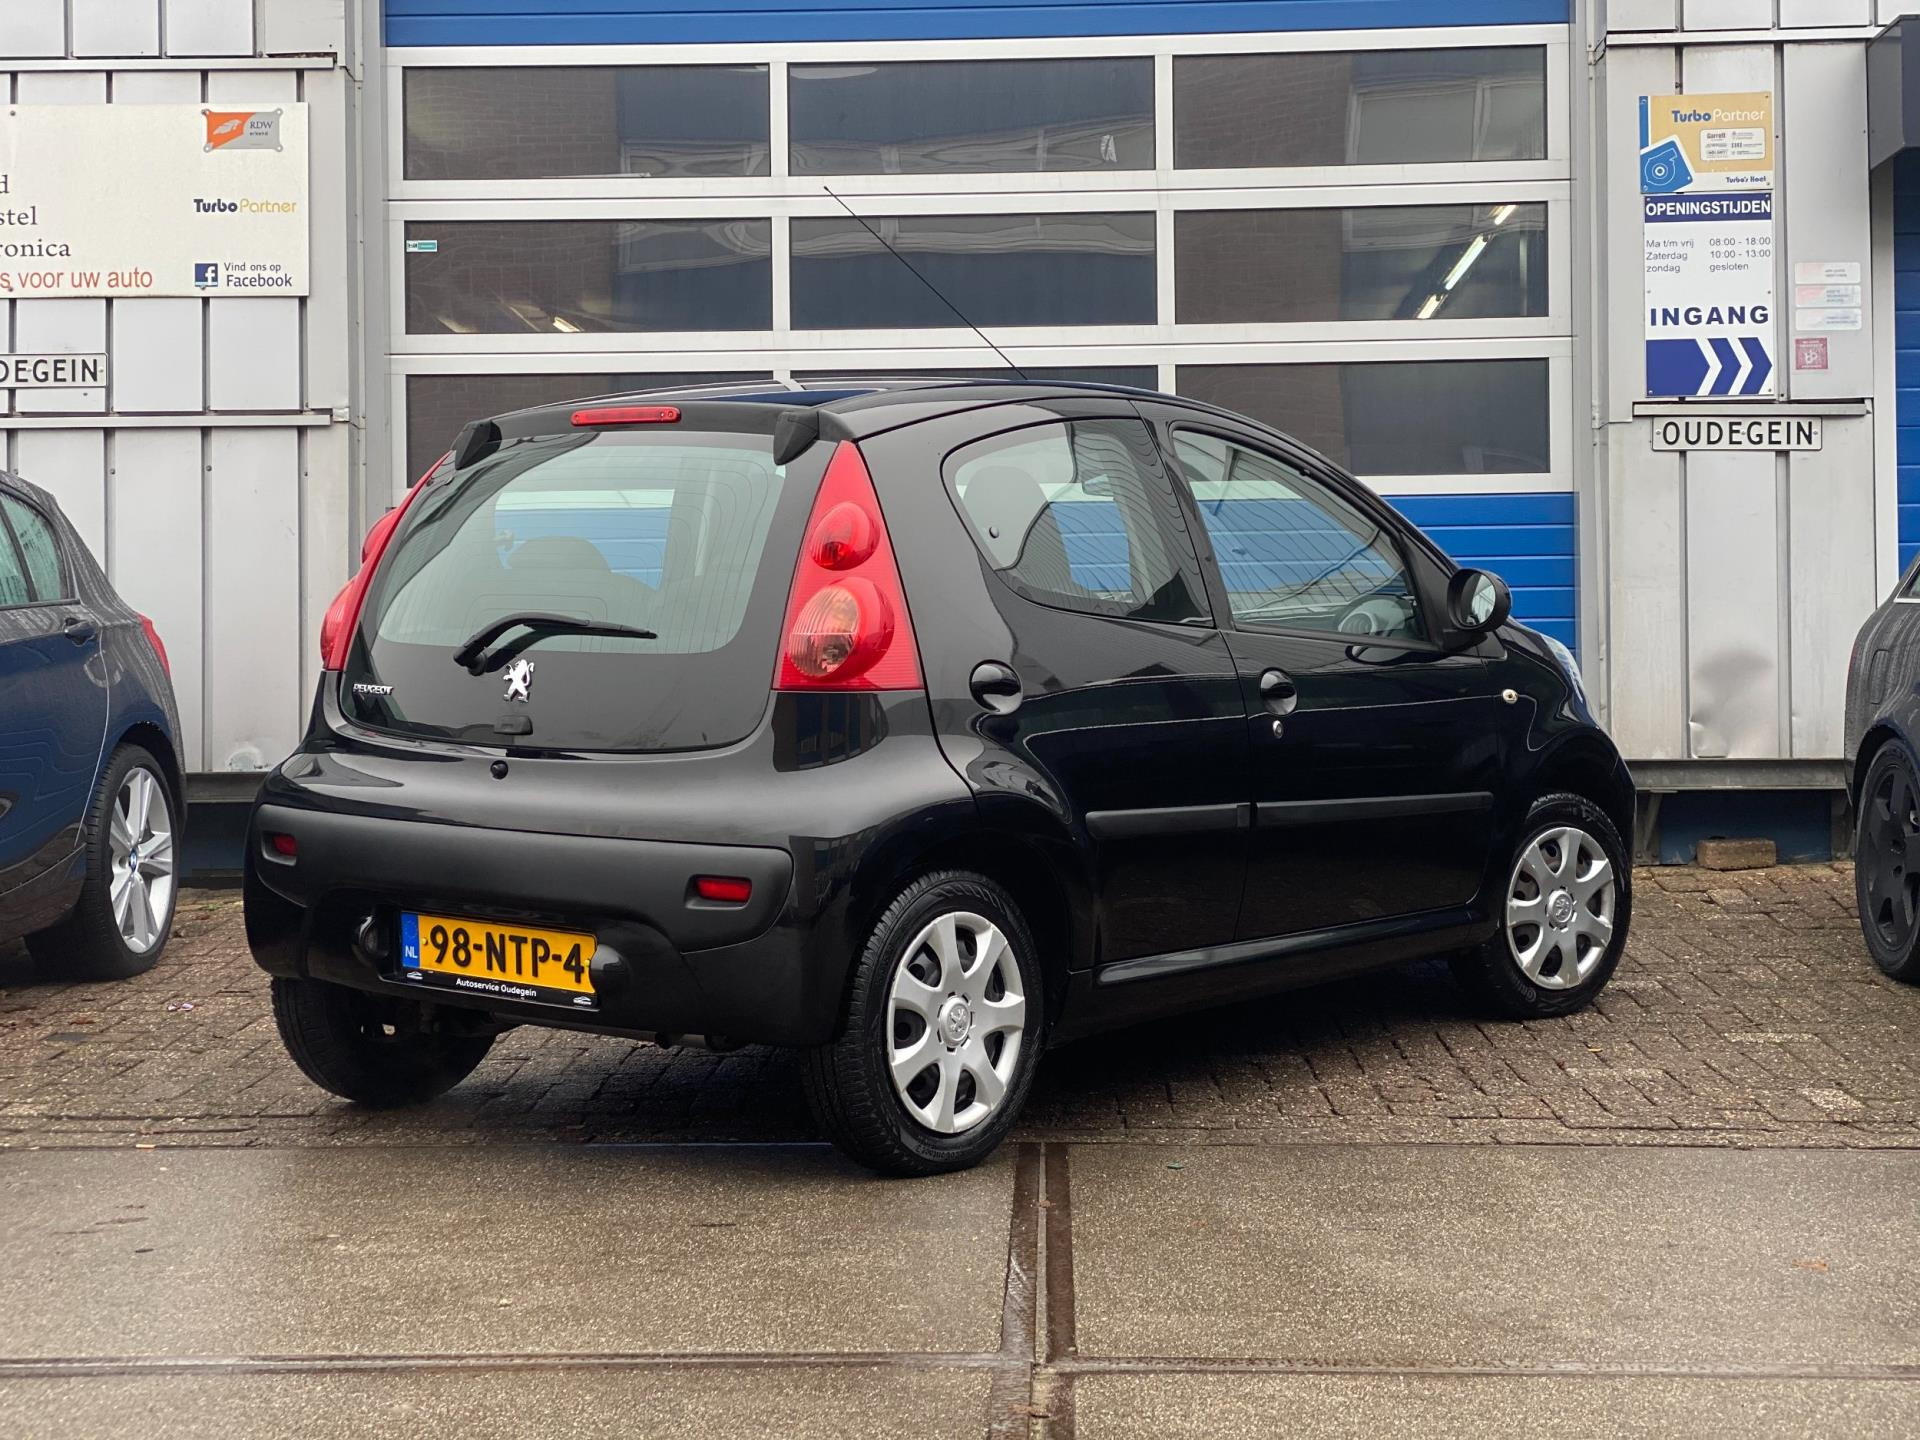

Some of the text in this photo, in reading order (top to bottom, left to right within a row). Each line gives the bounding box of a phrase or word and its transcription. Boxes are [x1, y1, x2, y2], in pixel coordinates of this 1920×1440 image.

[249, 120, 273, 129] RDW
[1645, 199, 1771, 216] OPENINGSTIJDEN
[1645, 239, 1661, 248] Ma
[1663, 239, 1678, 248] t/m
[1681, 239, 1694, 248] vrij
[1709, 237, 1736, 246] 08:00
[1745, 236, 1771, 246] 18:00
[1646, 251, 1688, 262] Zaterdag
[1710, 249, 1736, 259] 10:00
[1745, 249, 1771, 258] 13:00
[224, 262, 281, 274] Vind ons op
[1646, 262, 1749, 274] zondag gesloten
[17, 271, 64, 289] voor
[71, 271, 102, 288] uw
[107, 267, 153, 288] auto
[226, 273, 292, 287] Facebook
[1650, 305, 1769, 327] INGANG
[1662, 421, 1813, 445] OUDEGEIN
[352, 683, 394, 695] PEUGEOT
[404, 946, 418, 959] NL
[429, 924, 585, 984] 98-NTP-4
[455, 977, 537, 998] Autoservice Oudegein
